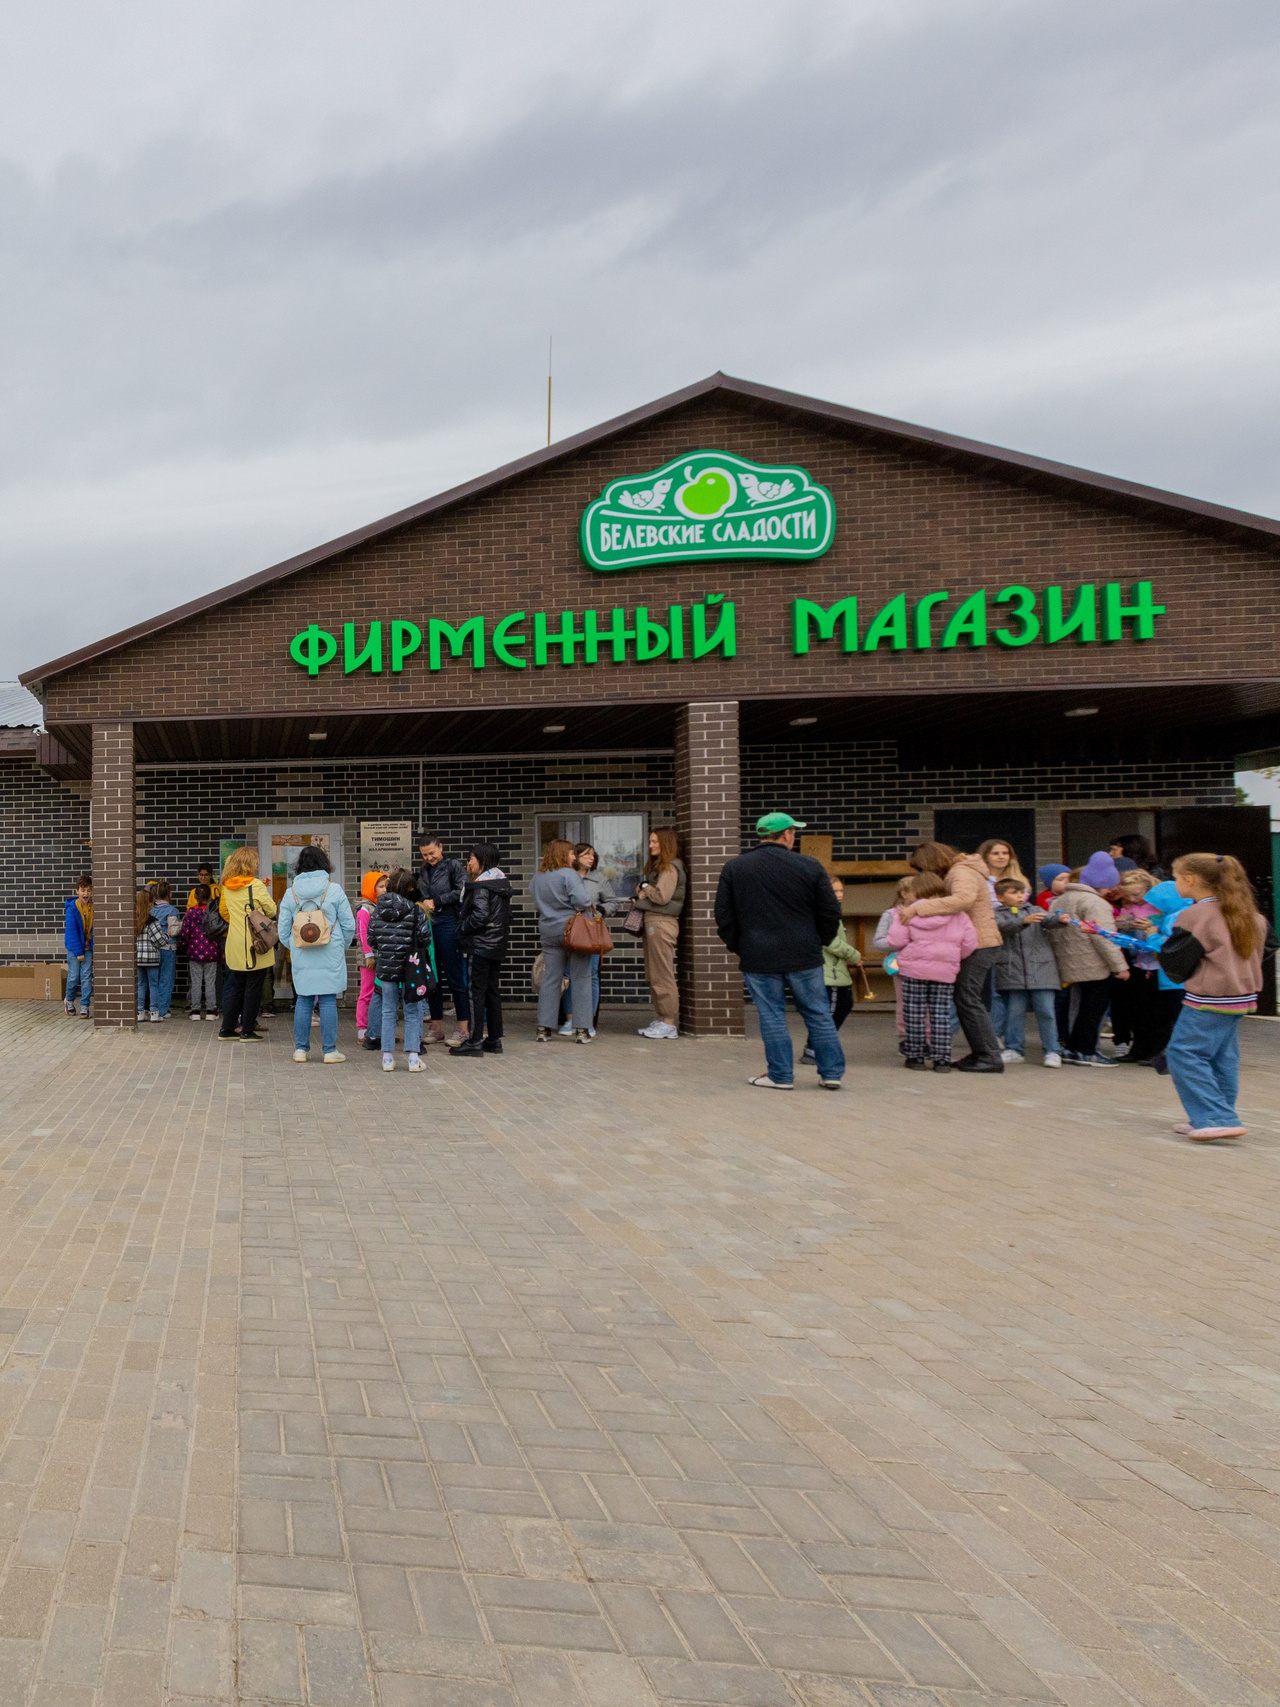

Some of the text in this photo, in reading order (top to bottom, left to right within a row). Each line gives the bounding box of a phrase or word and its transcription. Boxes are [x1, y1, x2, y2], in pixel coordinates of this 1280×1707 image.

[600, 509, 817, 552] БЕЛЕВСКИЕ СЛАДОСТИ
[290, 581, 1166, 676] ФИРМЕННЫЙ МАГАЗИН
